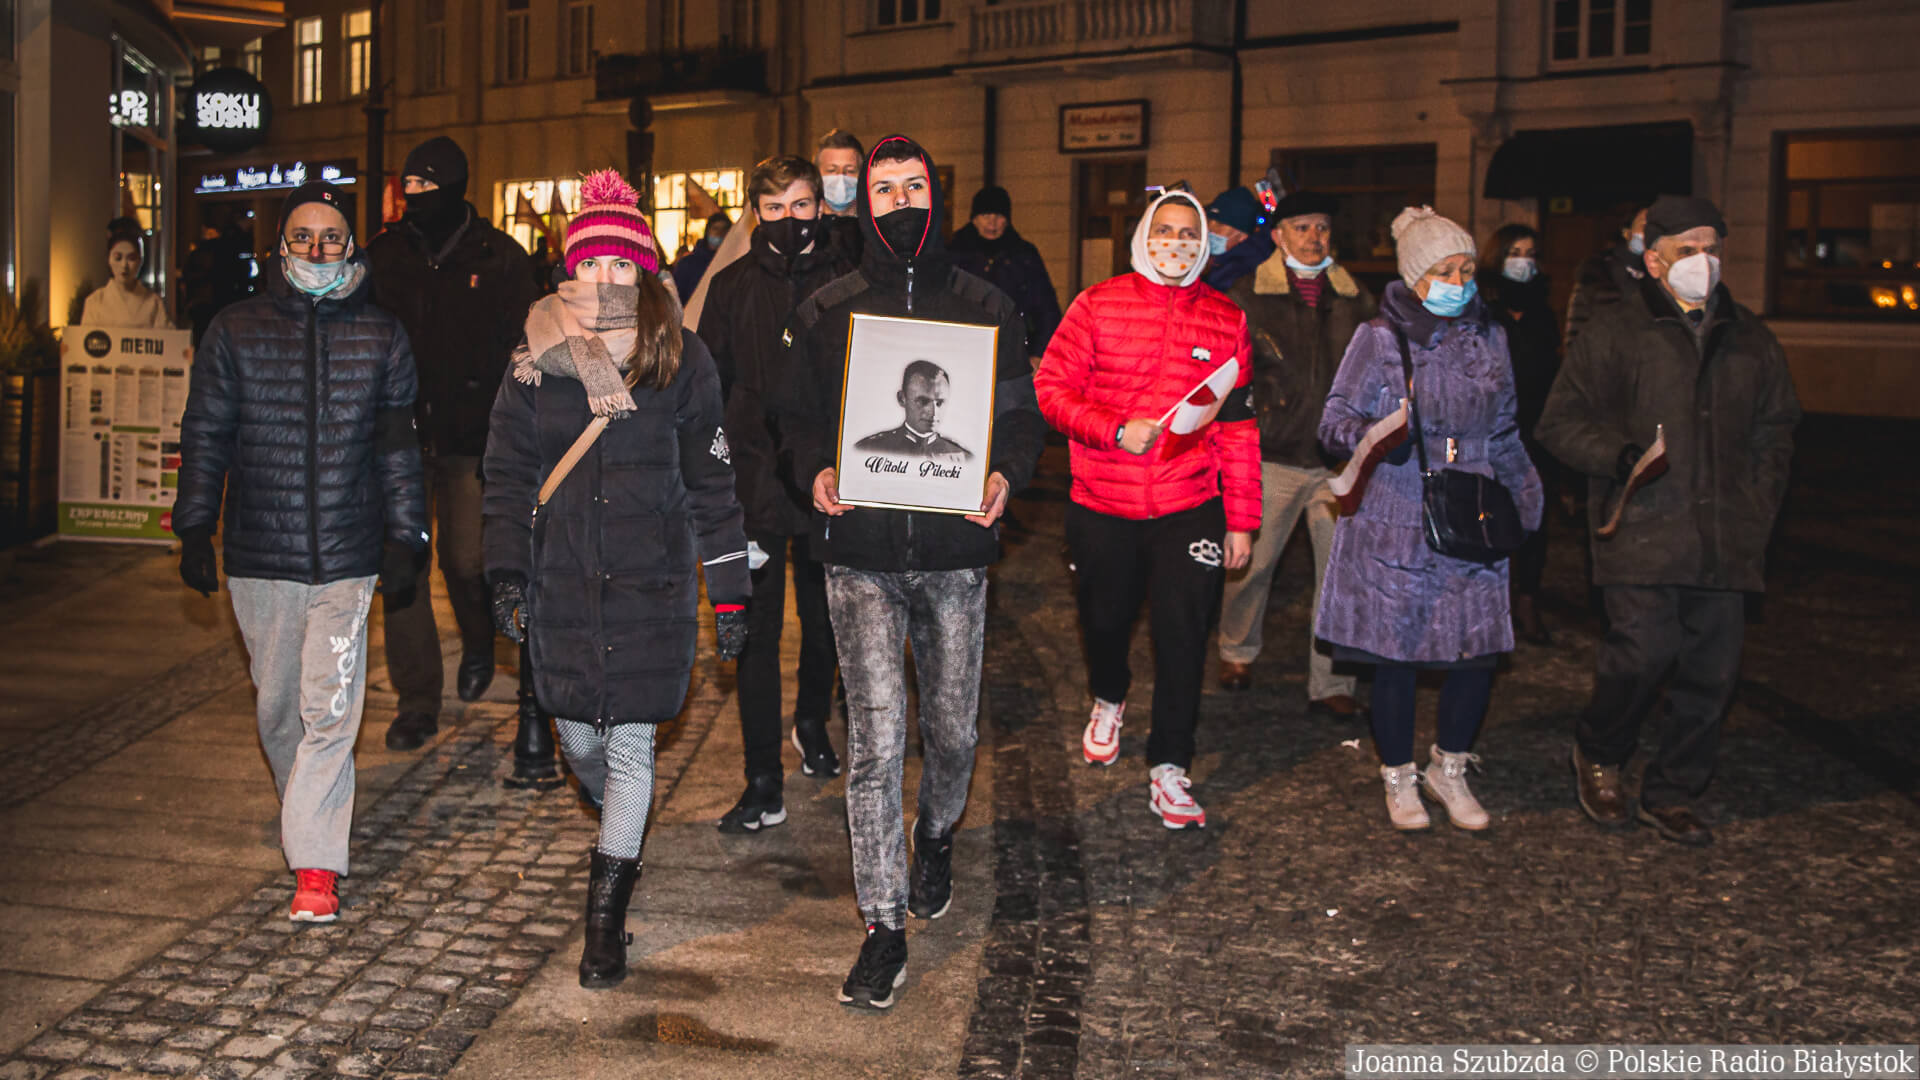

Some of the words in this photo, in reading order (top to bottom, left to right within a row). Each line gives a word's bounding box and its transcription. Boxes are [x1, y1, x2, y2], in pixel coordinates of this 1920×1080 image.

[197, 92, 260, 110] KOKU
[197, 109, 260, 128] SUSHI
[121, 338, 164, 355] MENU
[865, 456, 909, 474] Witold
[919, 460, 962, 479] Pilecki
